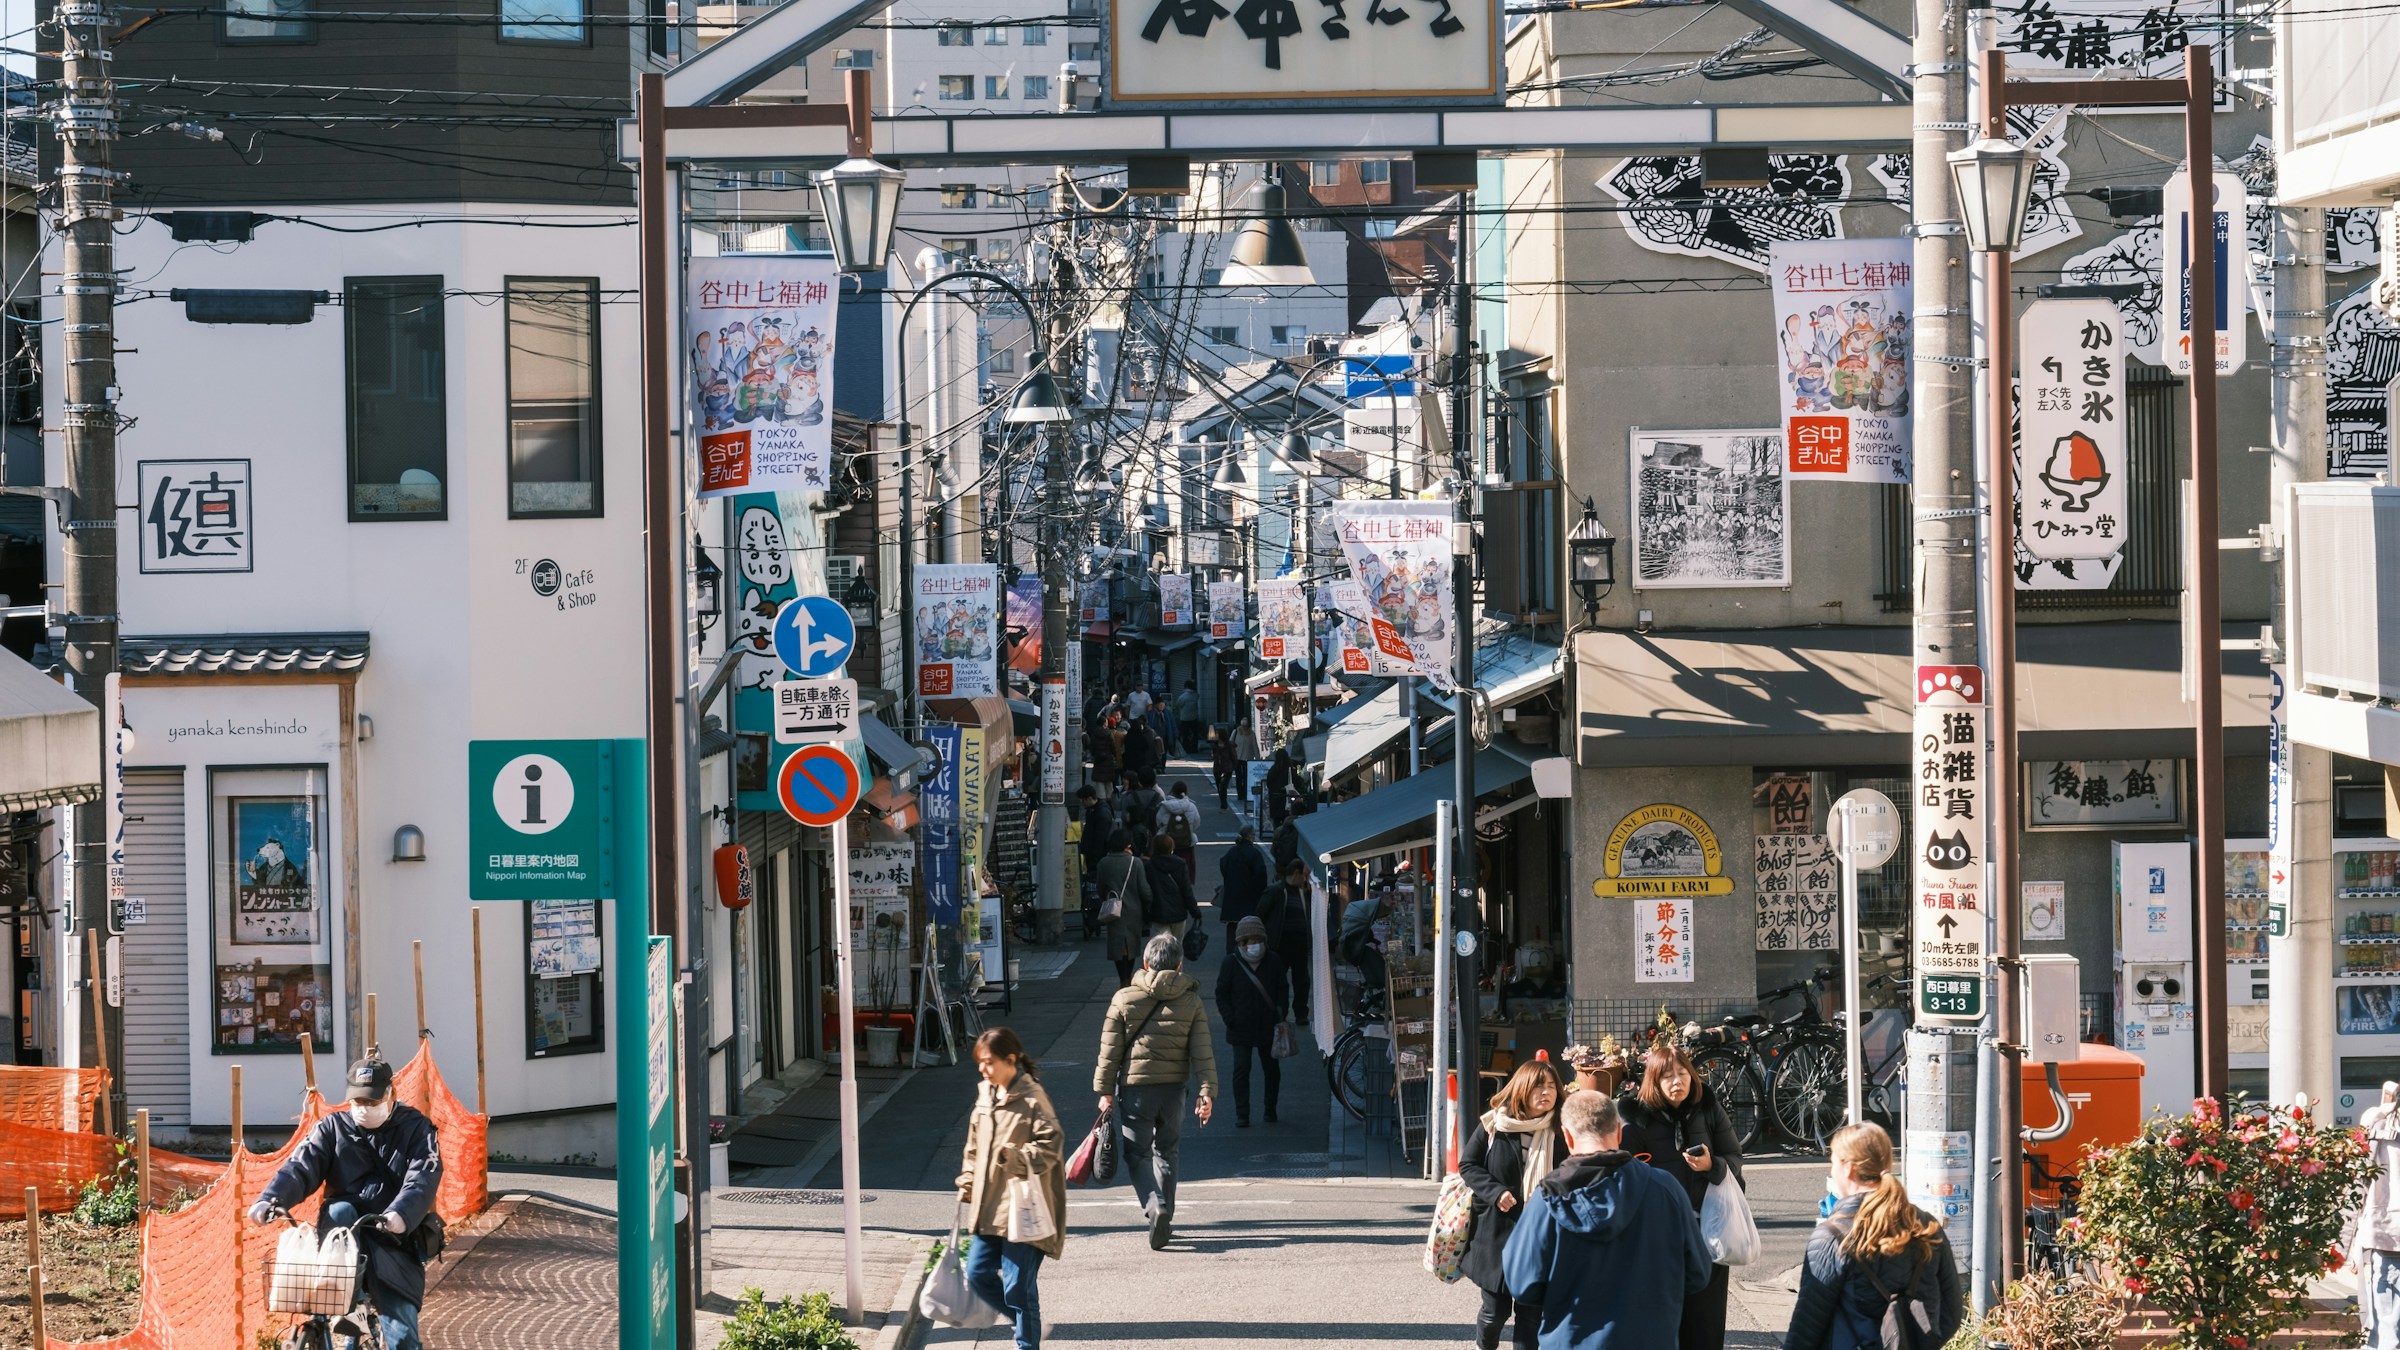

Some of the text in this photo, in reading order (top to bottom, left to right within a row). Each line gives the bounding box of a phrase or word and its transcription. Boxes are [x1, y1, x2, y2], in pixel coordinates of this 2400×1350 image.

[1784, 261, 1910, 288] 谷中七福神
[699, 280, 828, 305] 谷中七福神
[2080, 319, 2114, 424] かき氷
[2037, 387, 2072, 399] すぐ先
[2037, 400, 2072, 411] 左入る
[1855, 418, 1888, 429] TOKYO
[757, 428, 797, 439] TOKYO
[1797, 425, 1842, 444] 谷中
[1855, 430, 1894, 441] YANAKA
[707, 441, 745, 463] 谷中
[757, 440, 805, 450] YANAKA
[1855, 442, 1903, 454] SHOPPING
[757, 452, 818, 463] SHOPPING
[1798, 446, 1843, 465] ぎんざ
[1854, 455, 1891, 466] STREET
[709, 461, 744, 483] ぎんざ
[757, 464, 802, 475] STREET
[1342, 519, 1443, 540] 谷中七福神
[2032, 513, 2116, 539] ひみつ堂
[745, 520, 763, 575] ぐるい
[762, 516, 782, 578] しにもの
[515, 558, 594, 588] 2F Café
[921, 576, 991, 592] 谷中七福神
[557, 592, 596, 611] & Shop
[923, 669, 948, 680] 谷中
[781, 686, 850, 704] 自転車を除く
[923, 680, 949, 692] ぎんざ
[782, 703, 850, 720] 一方通行
[1048, 698, 1060, 736] かき氷
[168, 718, 307, 742] yanaka kenshindo
[1922, 733, 1941, 807] のお店
[1942, 712, 1975, 820] 猫雑貨
[1771, 784, 1809, 825] 飴
[1608, 807, 1718, 861] GENUINE DAIRY PRODUCTS
[1757, 835, 1795, 849] 自家製
[1798, 834, 1830, 848] 自家
[489, 855, 579, 868] 日暮里案内地図
[1756, 849, 1795, 872] あんず
[1796, 849, 1836, 868] ニッキ
[485, 871, 586, 881] Nippori Infomation Map
[831, 863, 909, 884] さんの味
[1761, 872, 1788, 893] 飴
[1803, 869, 1830, 890] 飴
[1616, 881, 1709, 893] KOIWAI FARM
[1949, 877, 1978, 890] Fusen
[1758, 893, 1796, 909] 自家製
[1800, 892, 1837, 907] 自家製
[1923, 892, 1977, 910] 布風船
[1680, 908, 1690, 941] 二月三日
[1757, 910, 1798, 929] ほうじ茶
[1801, 904, 1837, 933] ゆず
[1657, 901, 1680, 964] 節分祭
[1764, 928, 1788, 949] 飴
[1803, 930, 1831, 949] 飴
[1921, 942, 1979, 955] 30m先左側
[1921, 957, 1979, 968] 03-5685-6788
[1926, 980, 1972, 994] 西日暮里
[1930, 997, 1967, 1011] 3-13
[2351, 1022, 2376, 1031] FIRE
